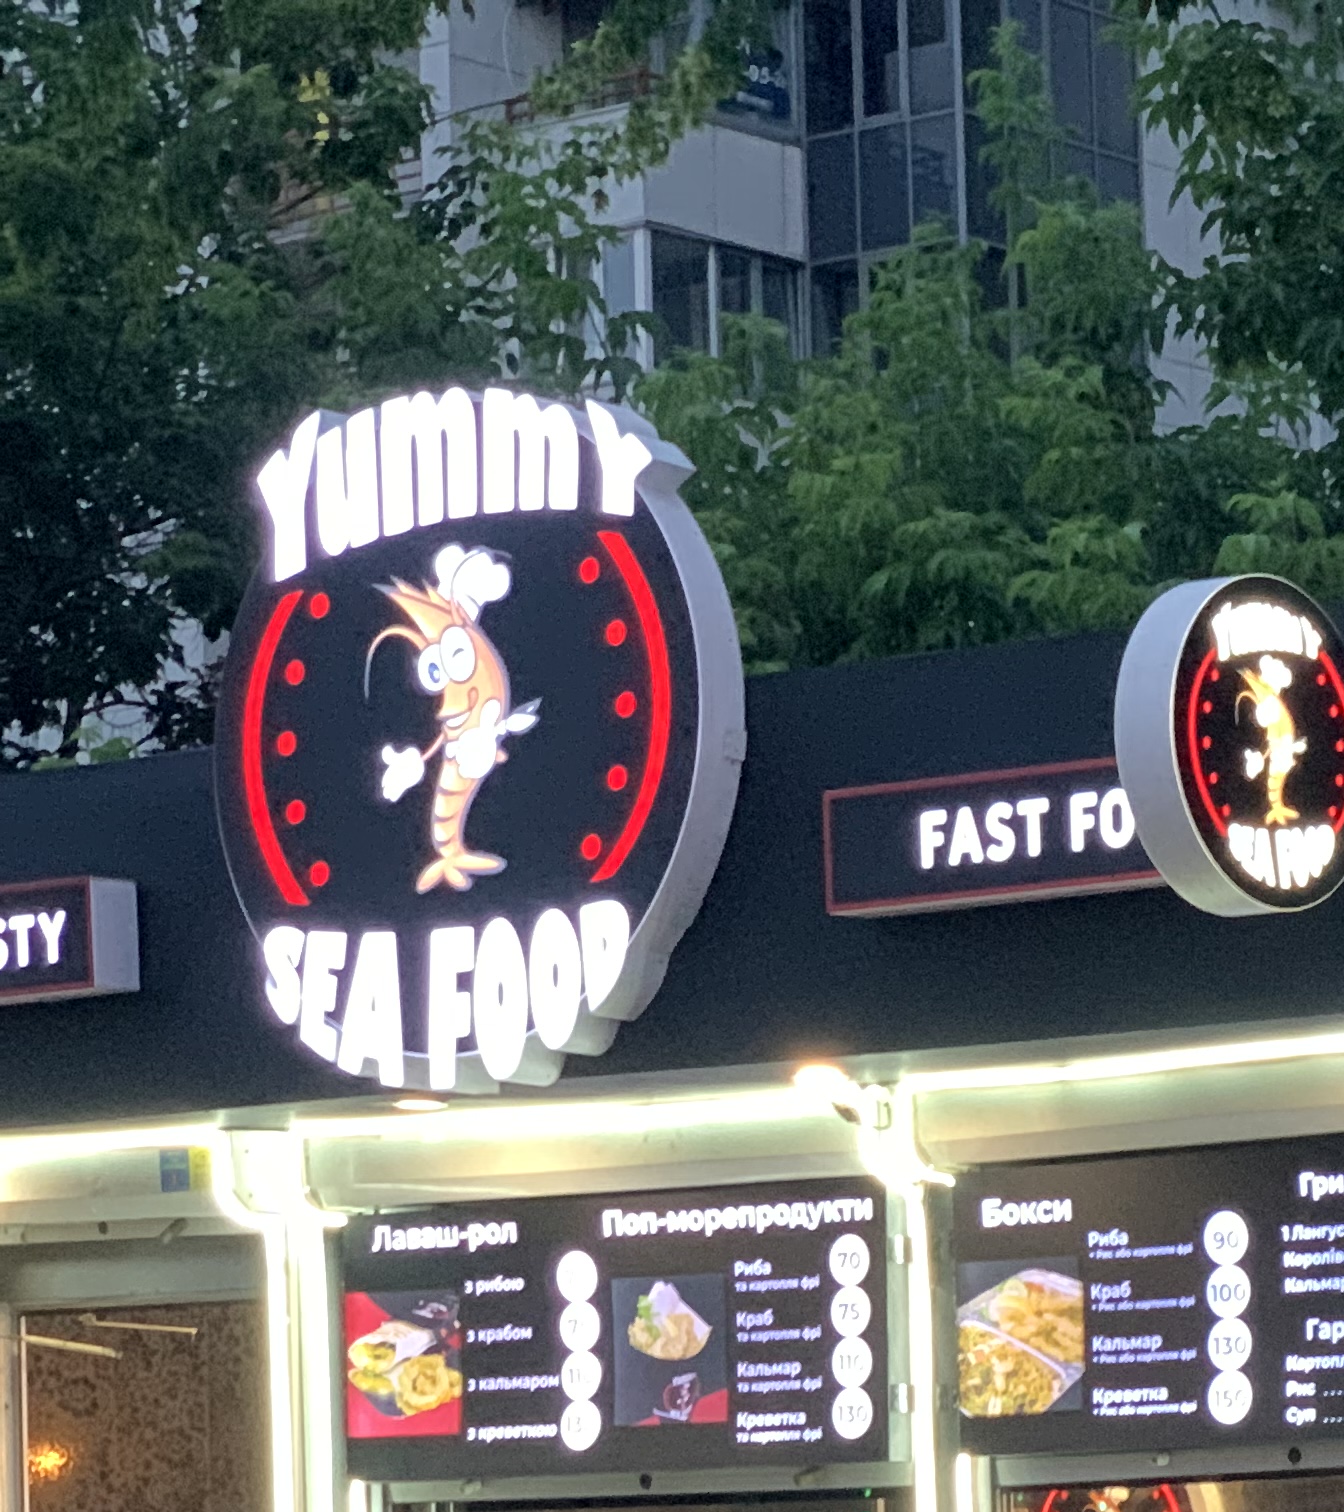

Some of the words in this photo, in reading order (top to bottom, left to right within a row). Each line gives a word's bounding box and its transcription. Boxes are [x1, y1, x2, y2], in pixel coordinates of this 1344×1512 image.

[918, 796, 1051, 870] FAST
[1069, 787, 1136, 854] FO
[262, 924, 404, 1087] SEA
[429, 899, 630, 1090] FOOD
[602, 1198, 873, 1237] Поп-морепродукти
[981, 1197, 1073, 1227] Бокси
[371, 1221, 518, 1252] Лаваш-рол
[1088, 1228, 1129, 1248] Риба
[1213, 1230, 1239, 1249] 90
[734, 1258, 772, 1277] Риба
[837, 1252, 860, 1269] 70
[476, 1275, 525, 1297] рибою
[1091, 1280, 1131, 1302] Краб
[1211, 1284, 1246, 1302] 100
[736, 1308, 774, 1330] Краб
[839, 1304, 860, 1320] 75
[466, 1329, 475, 1343] з
[478, 1323, 533, 1345] крабом
[1092, 1334, 1163, 1352] Кальмар
[1213, 1337, 1246, 1354] 130
[737, 1361, 802, 1379] Кальмар
[467, 1378, 476, 1392] з
[839, 1406, 867, 1422] 130
